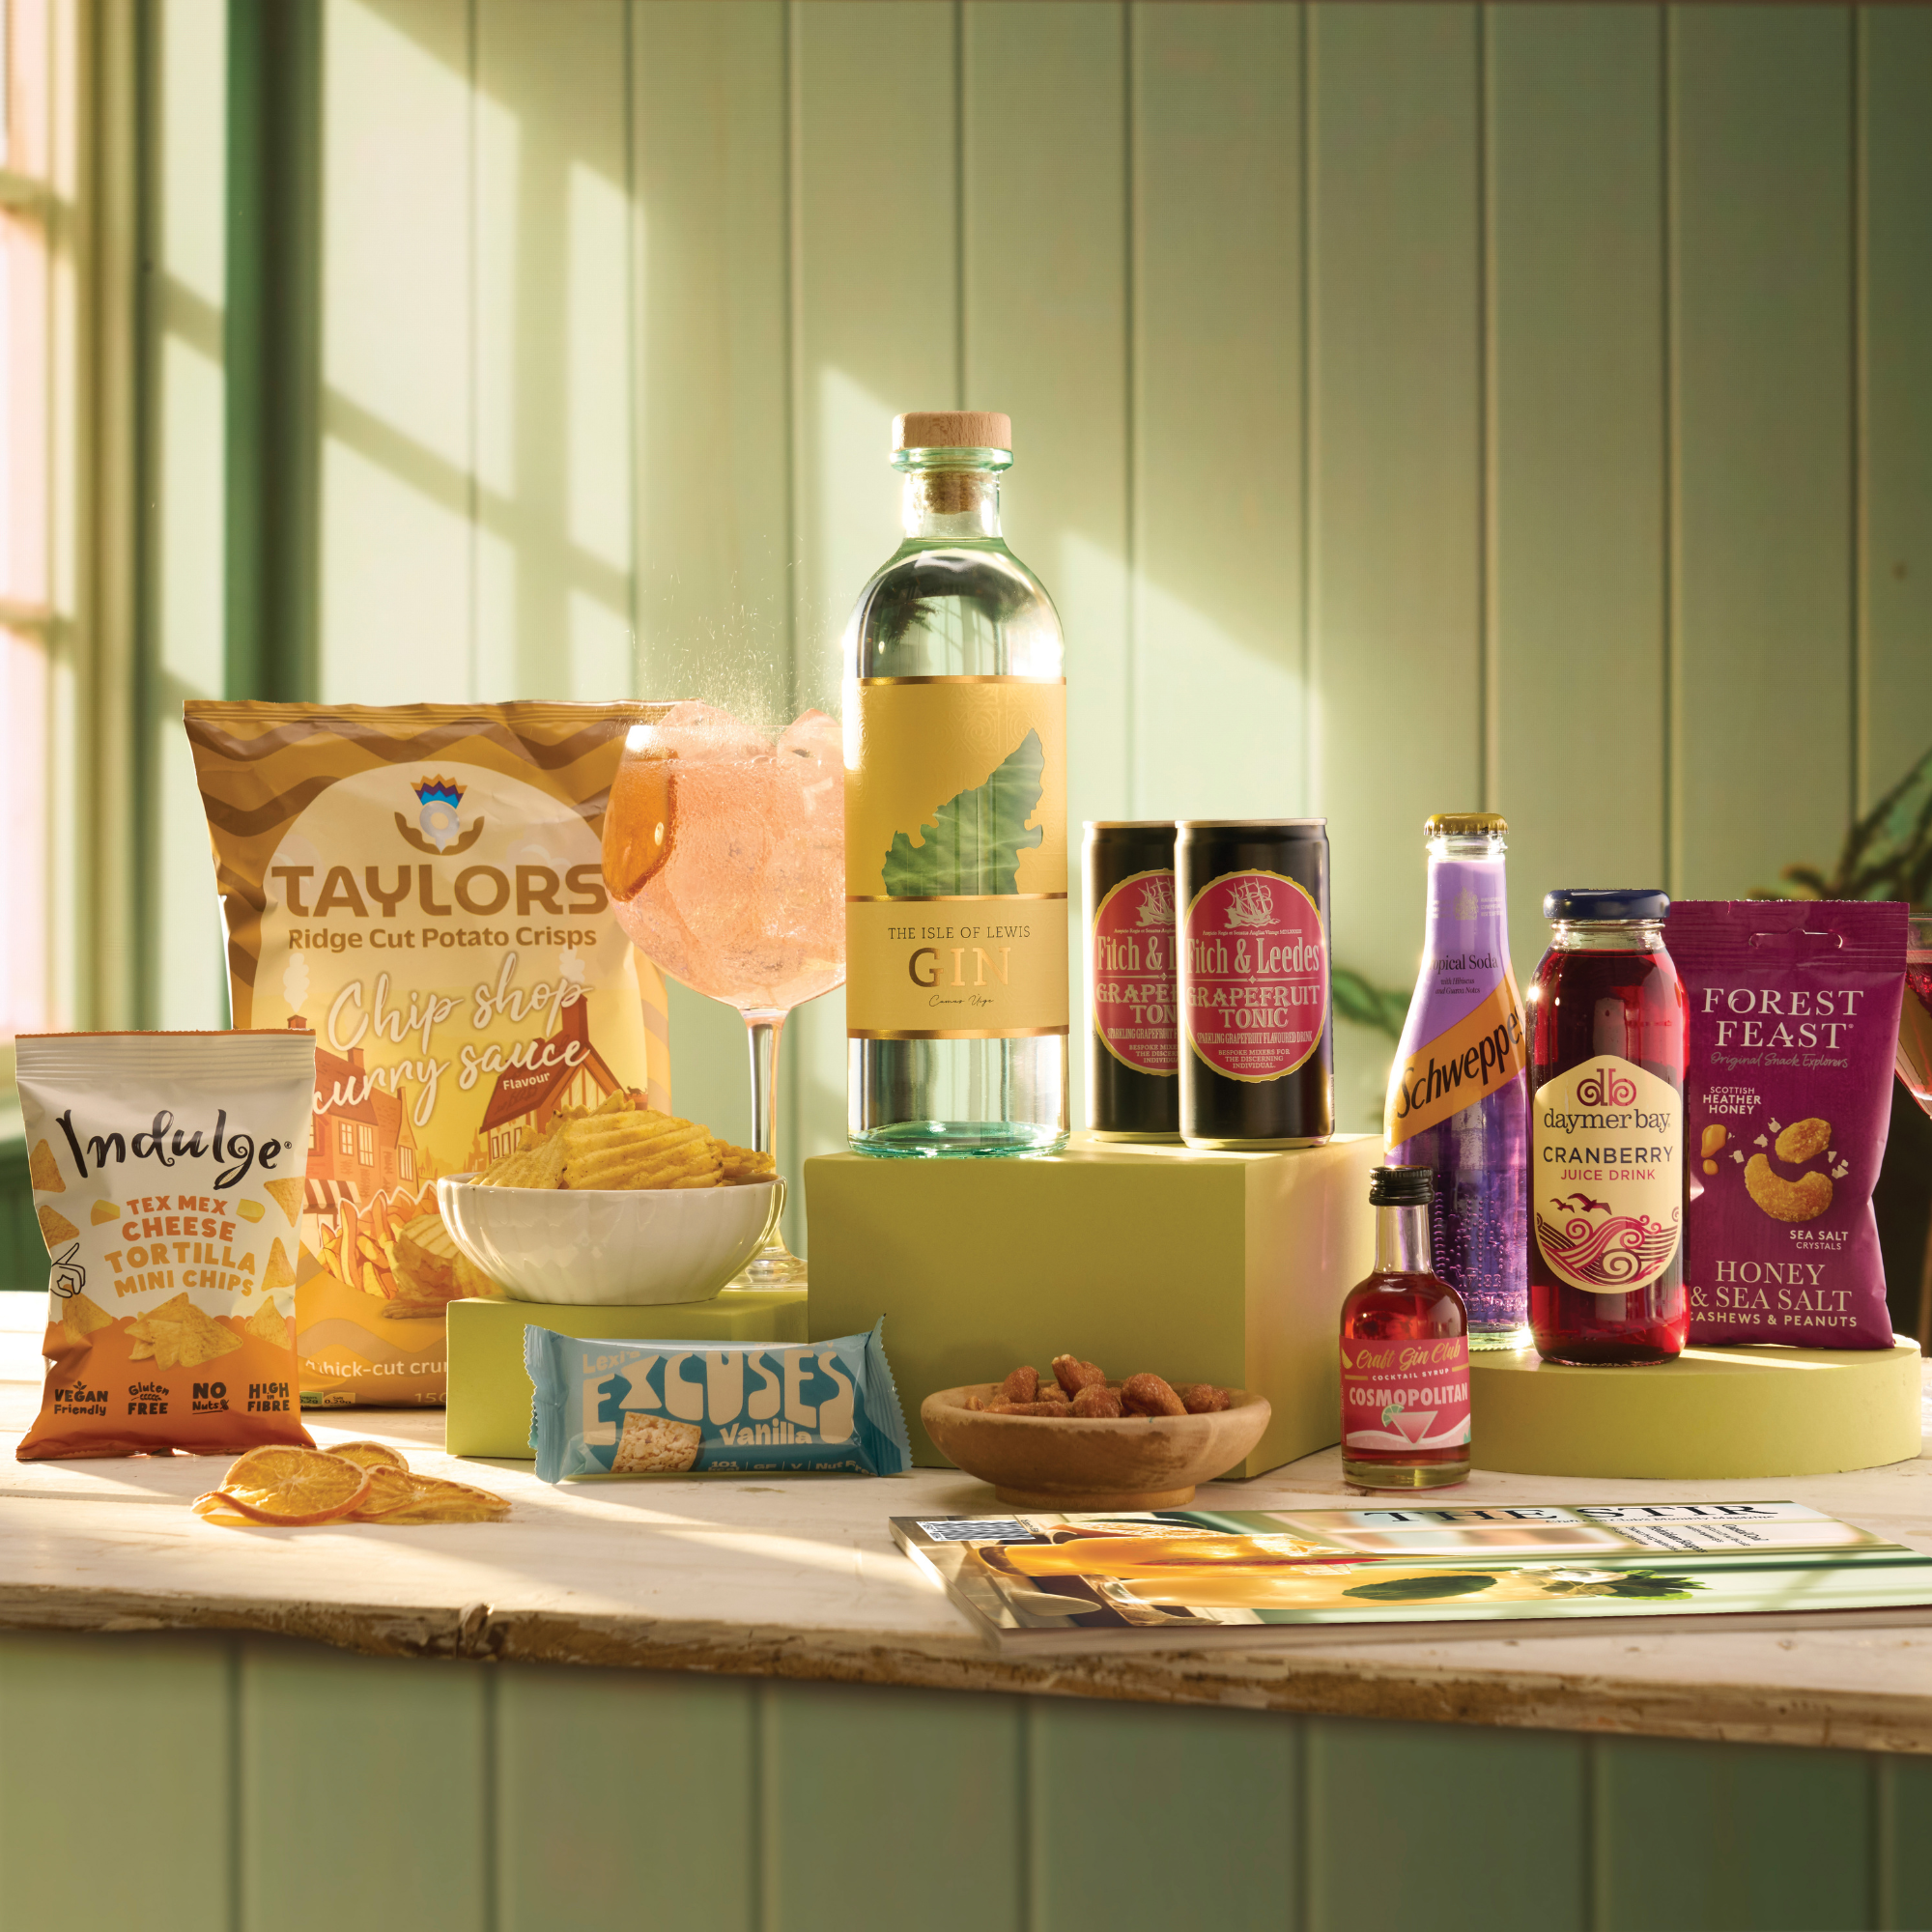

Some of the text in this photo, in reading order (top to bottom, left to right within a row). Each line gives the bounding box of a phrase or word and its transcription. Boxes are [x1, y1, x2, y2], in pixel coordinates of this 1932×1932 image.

[271, 864, 609, 918] TAYLORS
[289, 925, 597, 953] Ridge Cut Potato Crisps
[888, 925, 1031, 940] THE ISLE OF LEWIS
[1097, 936, 1140, 972] Fitch
[1146, 936, 1163, 971] &
[1187, 938, 1229, 974] Fitch
[1234, 938, 1252, 974] &
[1256, 937, 1320, 974] Leedes
[1469, 953, 1498, 970] Soda
[908, 947, 1011, 988] GIN
[327, 952, 594, 1054] Chip shop
[1186, 985, 1321, 1008] GRAPEFRUIT
[1701, 987, 1864, 1016] FOREST
[1129, 1005, 1177, 1025] TON
[1219, 1009, 1289, 1029] TONIC
[1107, 1028, 1136, 1039] SPARKLING
[1136, 1028, 1173, 1039] GRAPEFRUIT
[1197, 1031, 1313, 1044] SPARKLING GRAPEFRUIT FLAVOURED DRINK
[1714, 1020, 1847, 1049] FEAST
[1711, 1051, 1849, 1071] Original Snack Explorers
[312, 1039, 591, 1127] curry sauce
[502, 1072, 551, 1091] Flavour
[1710, 1086, 1755, 1095] SCOTTISH
[1703, 1094, 1762, 1105] HEATHER
[1709, 1104, 1755, 1115] HONEY
[56, 1109, 282, 1190] Indulge
[1543, 1146, 1673, 1165] CRANBERRY
[1561, 1169, 1656, 1181] JUICE DRINK
[127, 1195, 230, 1216] TEX MEX
[122, 1215, 237, 1243] CHEESE
[1789, 1230, 1849, 1241] SEA SALT
[1796, 1241, 1842, 1251] CRYSTALS
[104, 1241, 257, 1276] TORTILLA
[1715, 1260, 1826, 1286] HONEY
[114, 1269, 254, 1298] MINI CHIPS
[1690, 1286, 1853, 1312] & SEA SALT
[1767, 1315, 1777, 1326] &
[1783, 1315, 1858, 1327] PEANUTS
[582, 1350, 640, 1375] Lexi's
[1356, 1339, 1461, 1372] Craft Gin Club
[318, 1361, 405, 1378] thick-cut
[1372, 1368, 1449, 1381] COCKTAIL SYRUP
[54, 1388, 108, 1404] VEGAN
[128, 1382, 170, 1396] Gluten
[192, 1381, 227, 1400] NO
[248, 1382, 290, 1399] HIGH
[267, 1392, 275, 1401] in
[582, 1350, 855, 1446] EXCUSES
[1350, 1382, 1468, 1407] COSMOPOLITAN
[54, 1403, 107, 1417] Friendly
[128, 1403, 169, 1416] FREE
[192, 1400, 219, 1411] Nuts
[247, 1400, 291, 1412] FIBRE
[720, 1418, 812, 1447] Vanilla
[815, 1462, 843, 1470] Nut
[1364, 1504, 1778, 1523] THE STIR
